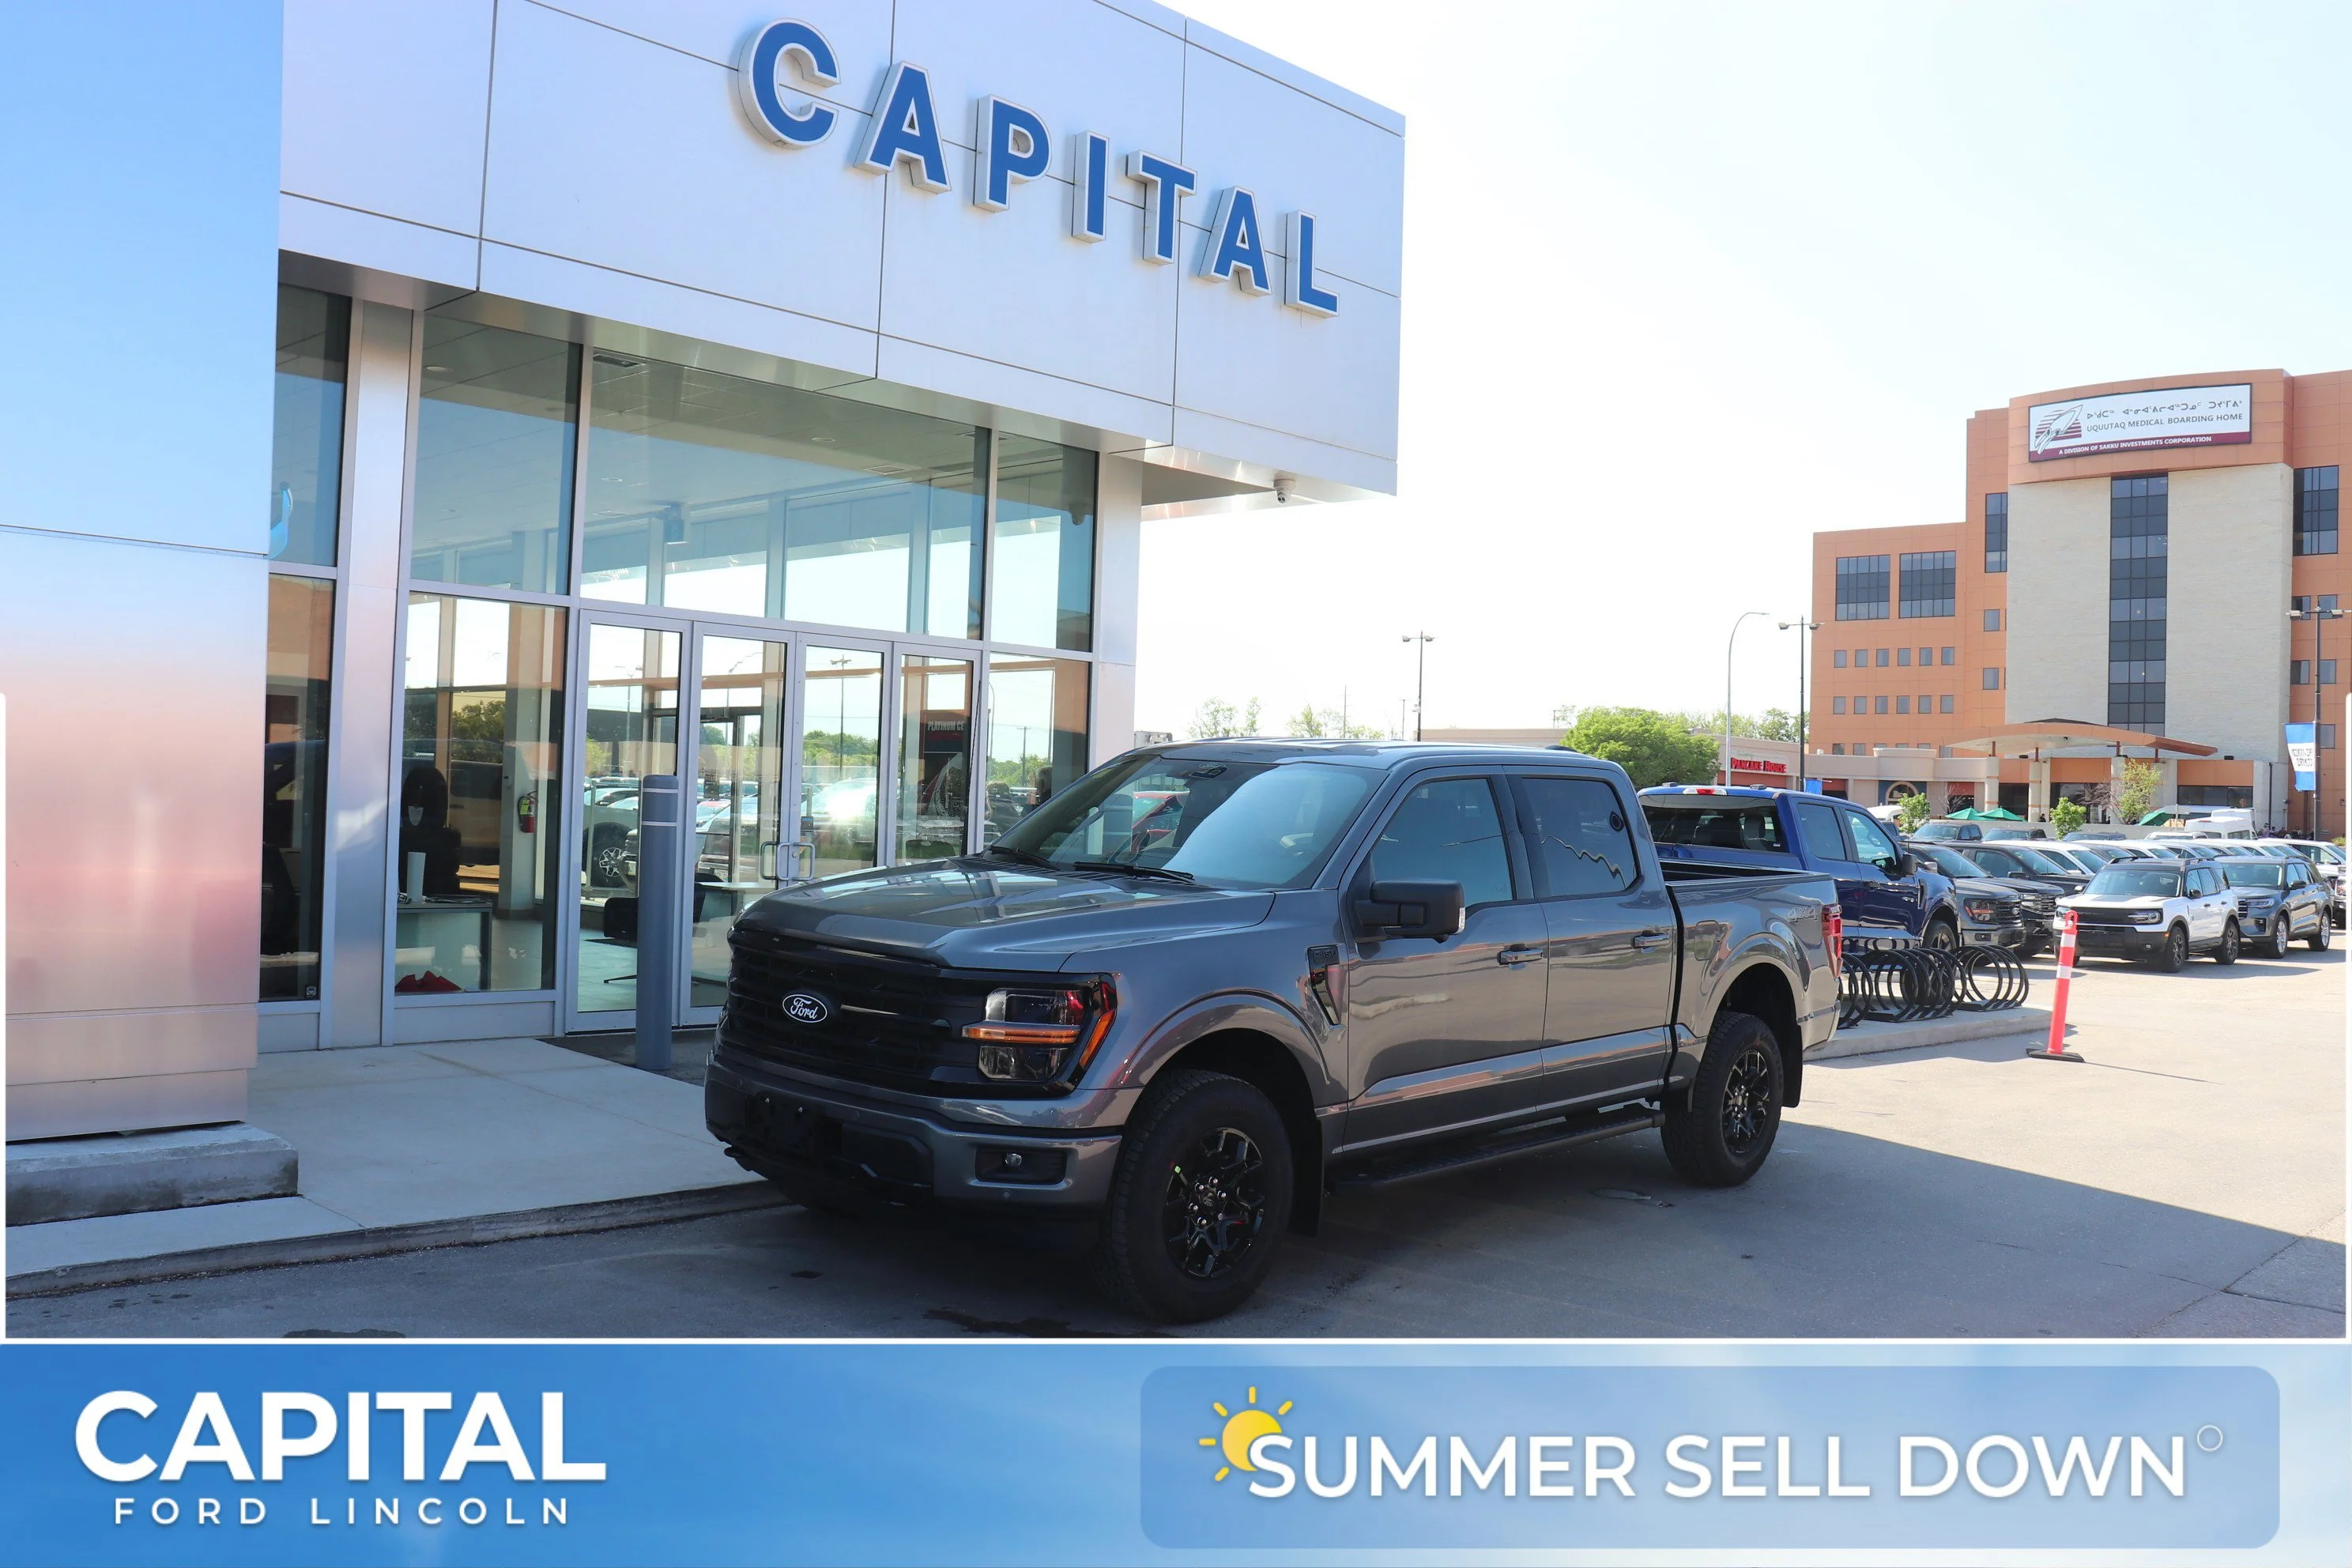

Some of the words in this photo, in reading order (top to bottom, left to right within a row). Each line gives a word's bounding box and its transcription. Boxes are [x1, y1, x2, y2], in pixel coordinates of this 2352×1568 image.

[738, 18, 1340, 318] CAPITAL
[2086, 421, 2126, 432] UQUUTAQ
[2128, 418, 2165, 428] MEDICAL
[2167, 415, 2214, 424] BOARDING
[2064, 446, 2090, 454] DIVISION
[2120, 439, 2163, 449] INVESTMENTS
[2164, 435, 2212, 444] CORPORATION
[789, 997, 820, 1020] Ford
